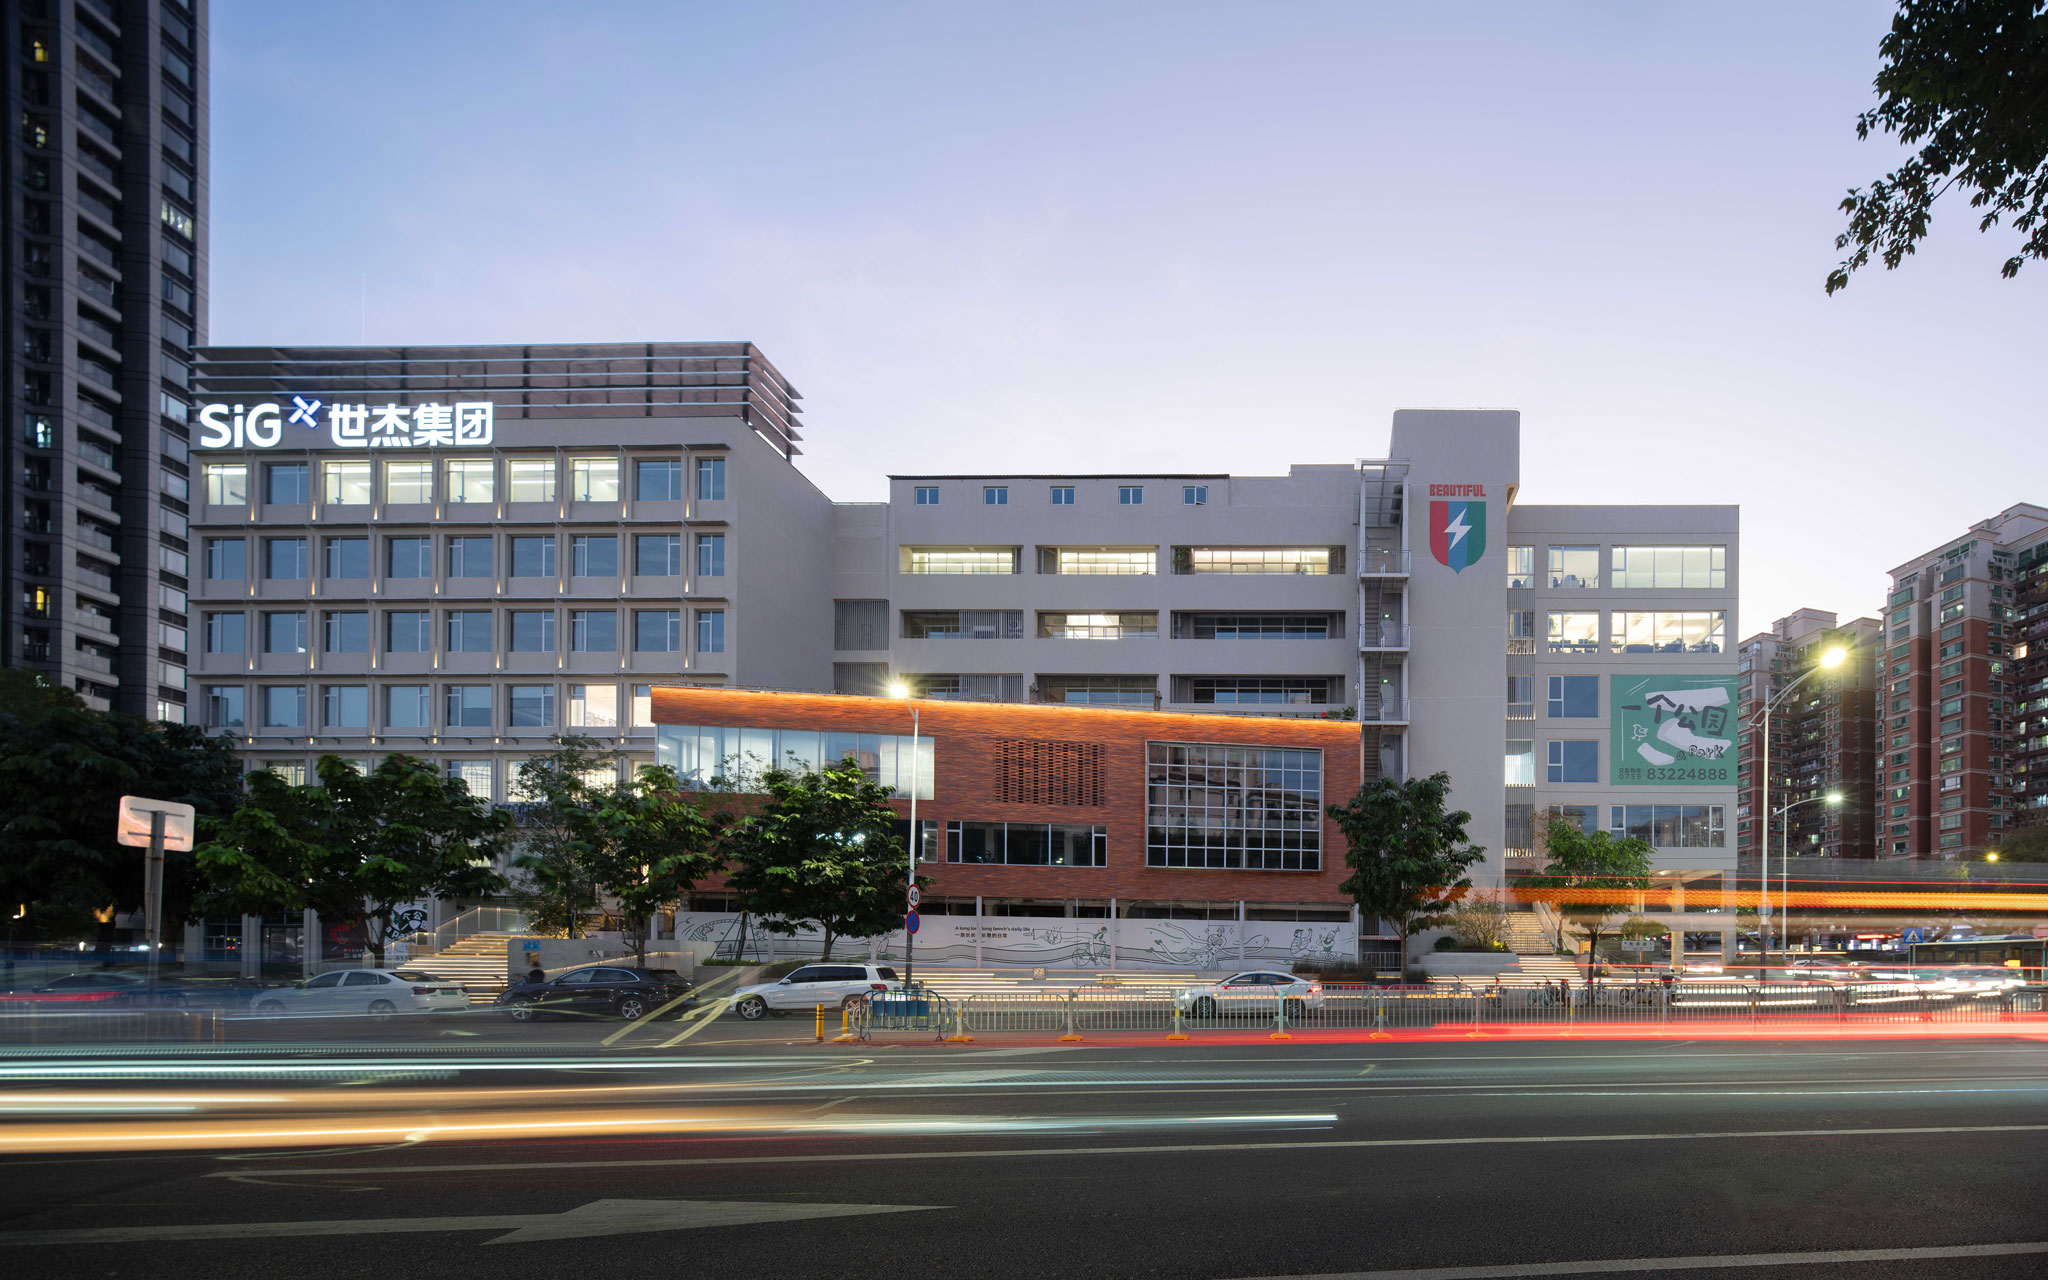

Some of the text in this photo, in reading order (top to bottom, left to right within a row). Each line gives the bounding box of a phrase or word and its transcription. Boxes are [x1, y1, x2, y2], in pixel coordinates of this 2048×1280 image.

[200, 403, 282, 448] SiG
[328, 402, 494, 447] 世杰集团
[1429, 484, 1486, 497] BEAUTIFUL
[1647, 768, 1728, 780] 83224888
[910, 890, 919, 902] 40
